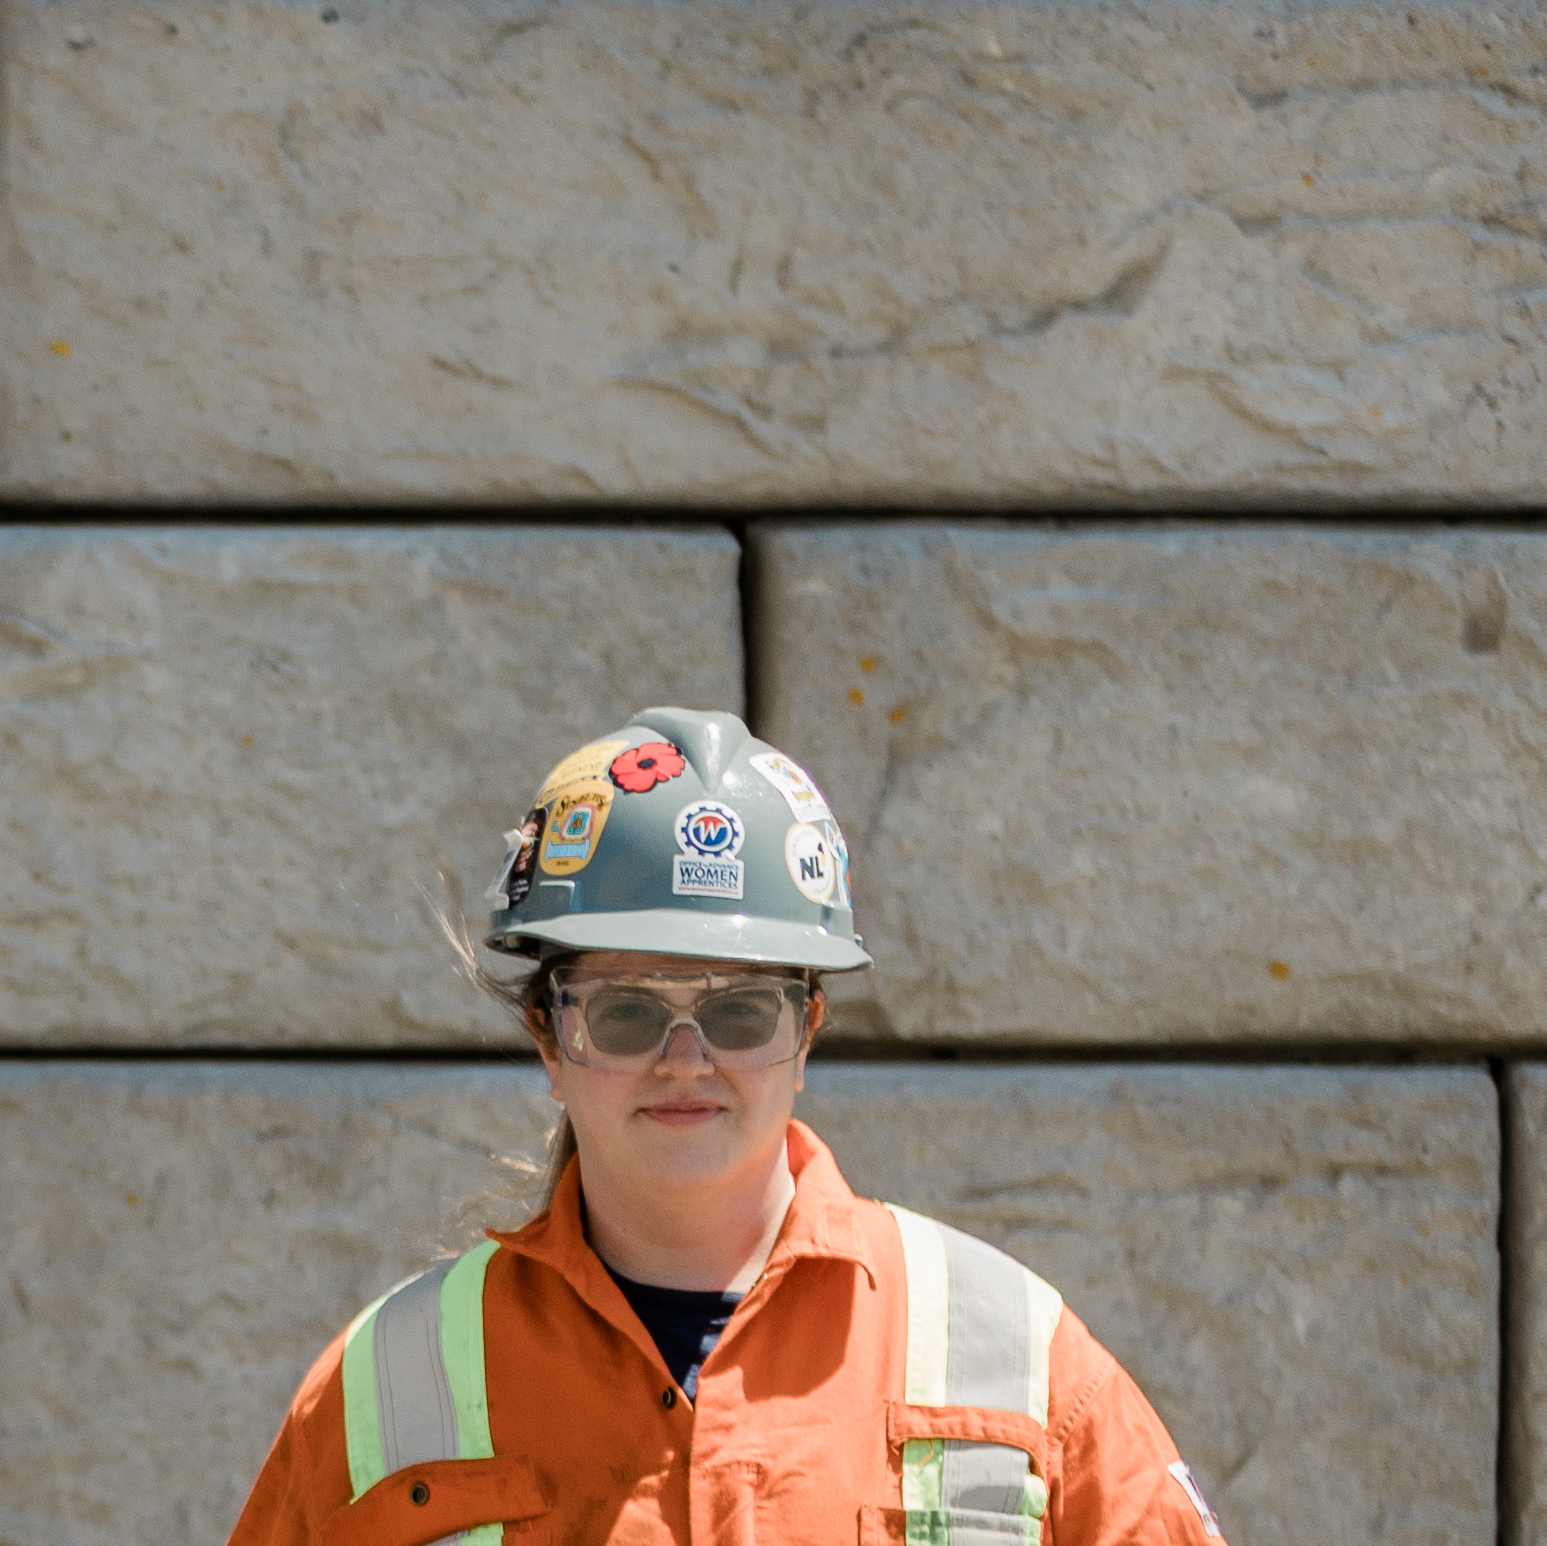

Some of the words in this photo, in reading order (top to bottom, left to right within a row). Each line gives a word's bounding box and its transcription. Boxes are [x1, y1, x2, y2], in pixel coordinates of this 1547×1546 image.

[680, 866, 738, 882] WOMEN
[799, 856, 825, 881] NL
[680, 878, 738, 889] APPRENTICES
